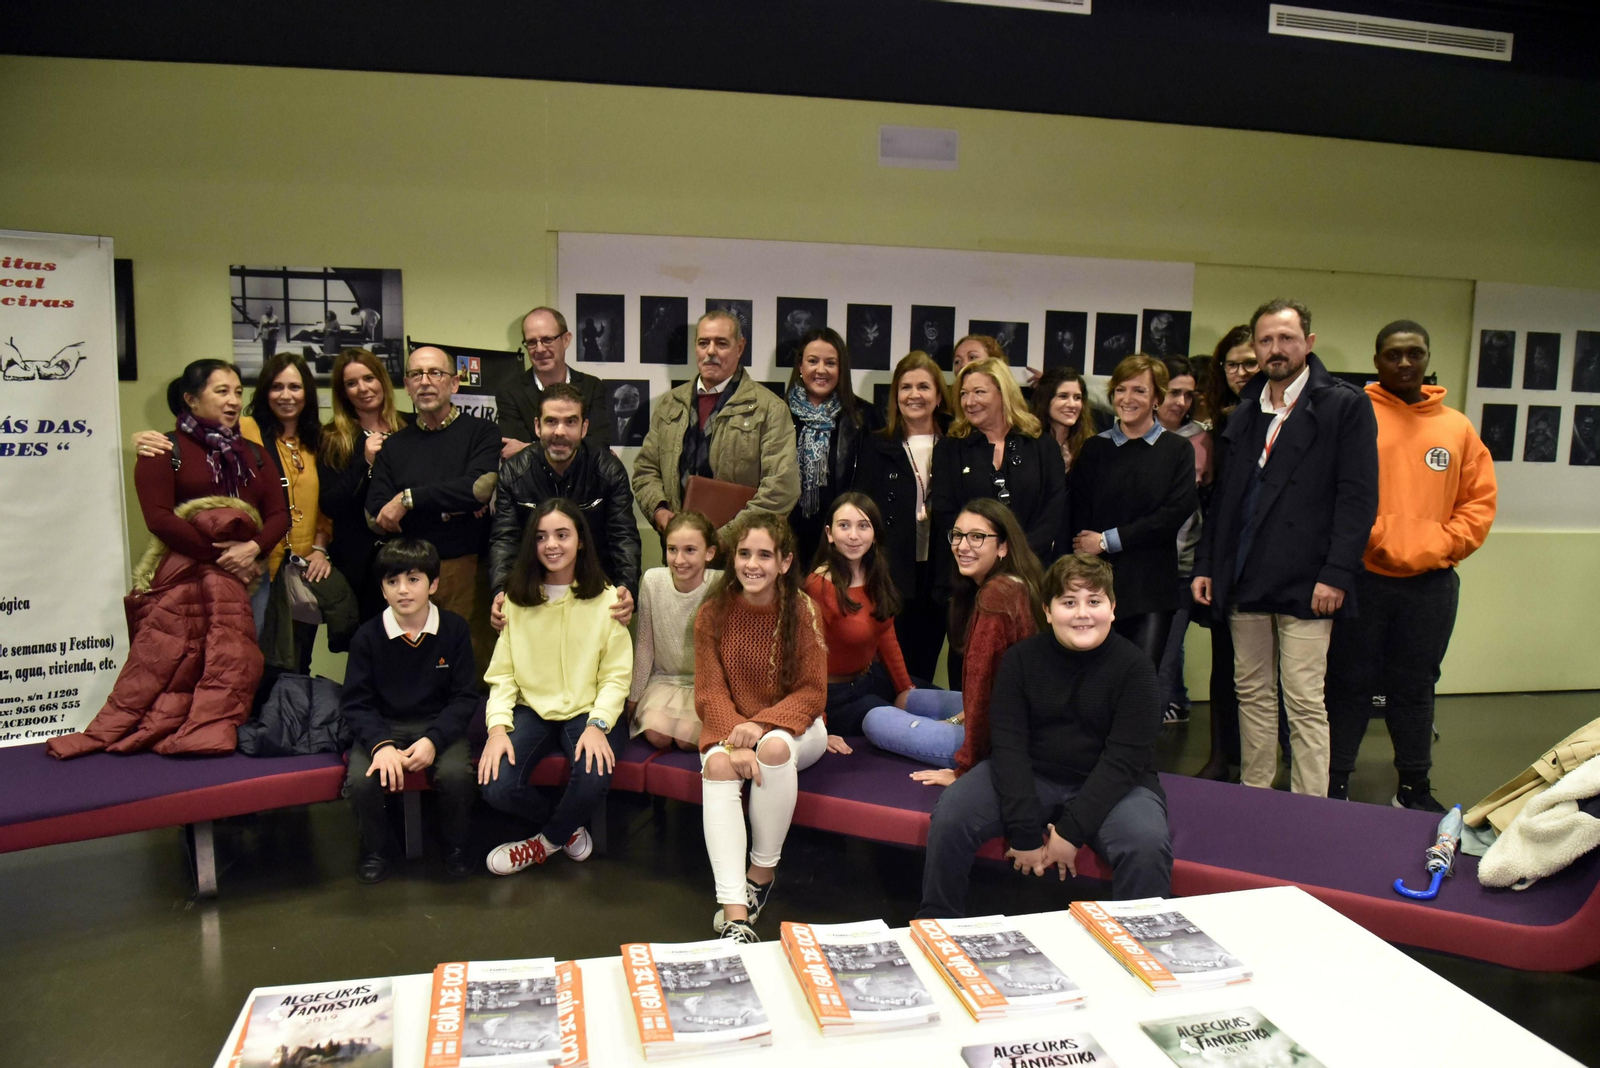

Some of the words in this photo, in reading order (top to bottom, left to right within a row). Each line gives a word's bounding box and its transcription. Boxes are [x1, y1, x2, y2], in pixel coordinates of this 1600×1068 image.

[0, 277, 46, 290] cal
[1, 295, 75, 309] ciras
[471, 360, 478, 369] A
[471, 374, 478, 383] F
[34, 419, 93, 438] DAS,
[11, 641, 57, 656] semanas
[60, 642, 66, 656] y
[69, 634, 114, 651] Festivos)
[15, 666, 47, 682] agua,
[49, 658, 97, 675] vivienda,
[99, 657, 117, 670] etc.
[27, 693, 43, 702] s/n
[47, 688, 79, 700] 11203
[15, 704, 36, 715] 956
[39, 702, 58, 712] 668
[61, 700, 81, 710] 555
[1080, 902, 1108, 921] OCIO
[791, 924, 815, 947] OCIO
[918, 920, 946, 939] OCIO
[1099, 921, 1122, 935] DE
[628, 944, 651, 966] OCIO
[799, 946, 822, 963] DE
[934, 939, 959, 956] DE
[442, 963, 465, 987] OCIO
[632, 966, 656, 984] DE
[280, 984, 372, 1006] ALGECIRAS
[439, 987, 463, 1006] DE
[305, 1013, 338, 1025] 2019
[1176, 1016, 1251, 1038] ALGECIRAS
[994, 1038, 1079, 1058] ALGECIRAS
[1221, 1043, 1249, 1054] 2019
